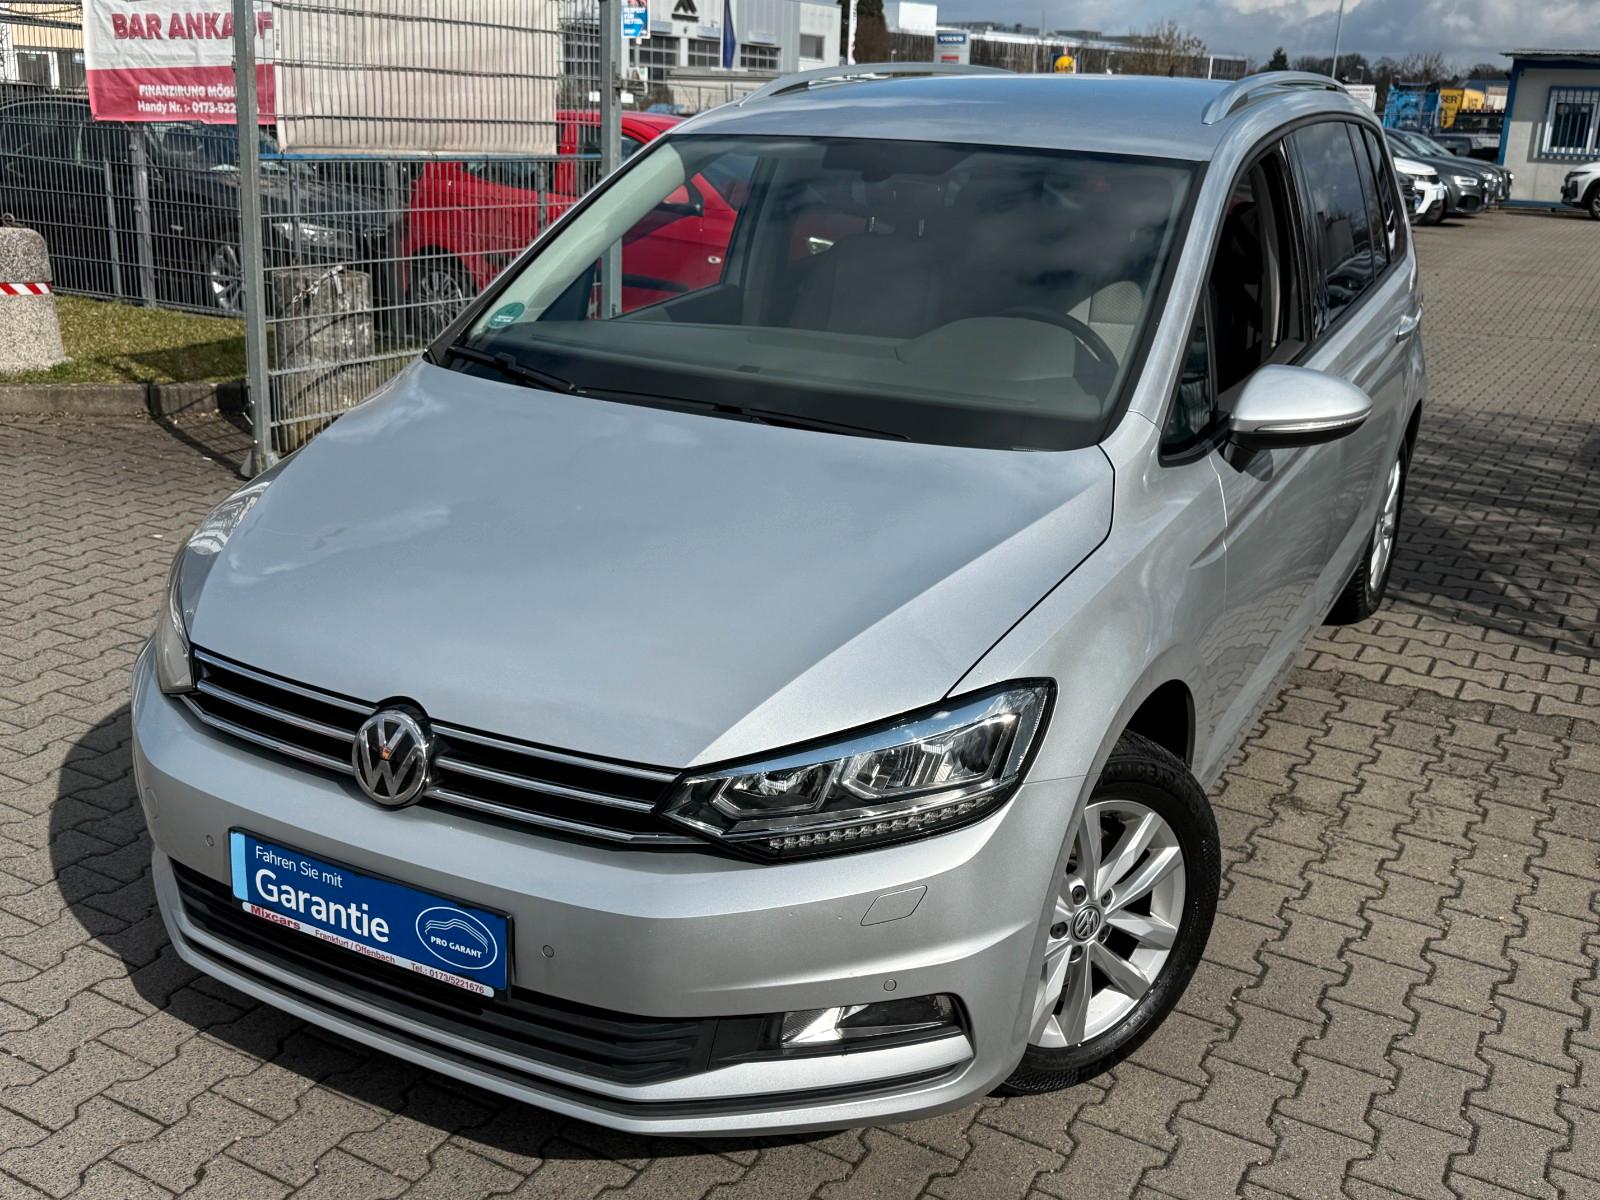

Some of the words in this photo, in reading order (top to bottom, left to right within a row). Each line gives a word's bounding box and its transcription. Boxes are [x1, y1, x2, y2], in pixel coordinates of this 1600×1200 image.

[112, 12, 163, 40] BAR
[168, 11, 272, 40] ANKAF
[137, 100, 167, 114] Handy
[169, 101, 182, 112] Nr.
[192, 102, 260, 114] 0173-522
[255, 845, 297, 872] Fahren
[300, 861, 319, 879] Sie
[322, 872, 343, 888] mit
[250, 904, 301, 929] Mixcars
[255, 868, 390, 943] Garantie
[314, 929, 349, 947] Frankfurt
[355, 943, 396, 964] Offenbach
[430, 936, 448, 947] PRO
[449, 942, 482, 958] GARANT
[429, 969, 485, 994] 0173/5221676
